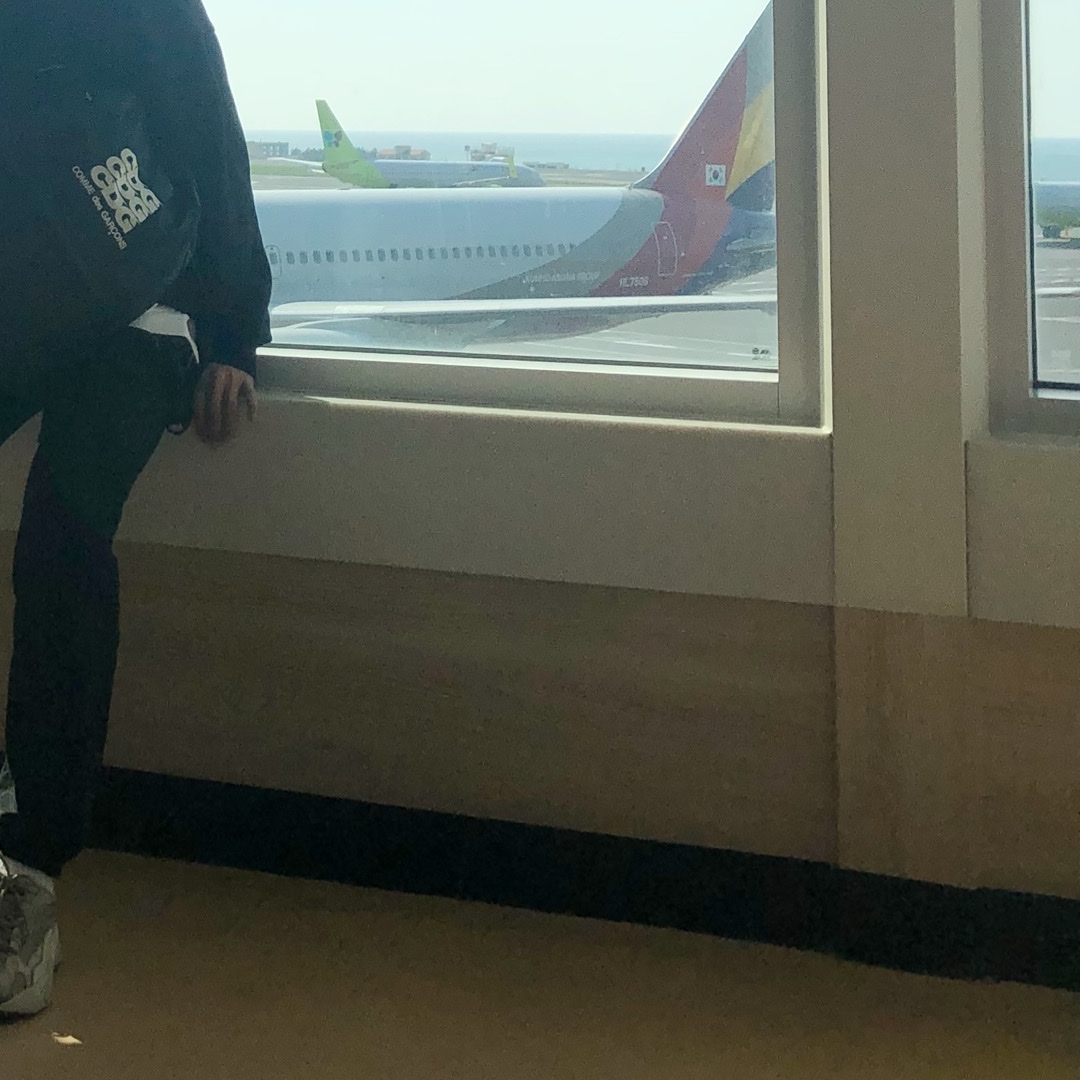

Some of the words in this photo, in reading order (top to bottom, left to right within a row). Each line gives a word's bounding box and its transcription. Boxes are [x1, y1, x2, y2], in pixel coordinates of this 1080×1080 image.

[72, 165, 96, 195] COMME
[92, 195, 102, 211] des
[101, 210, 127, 250] GARÇONS
[90, 165, 139, 234] CDG
